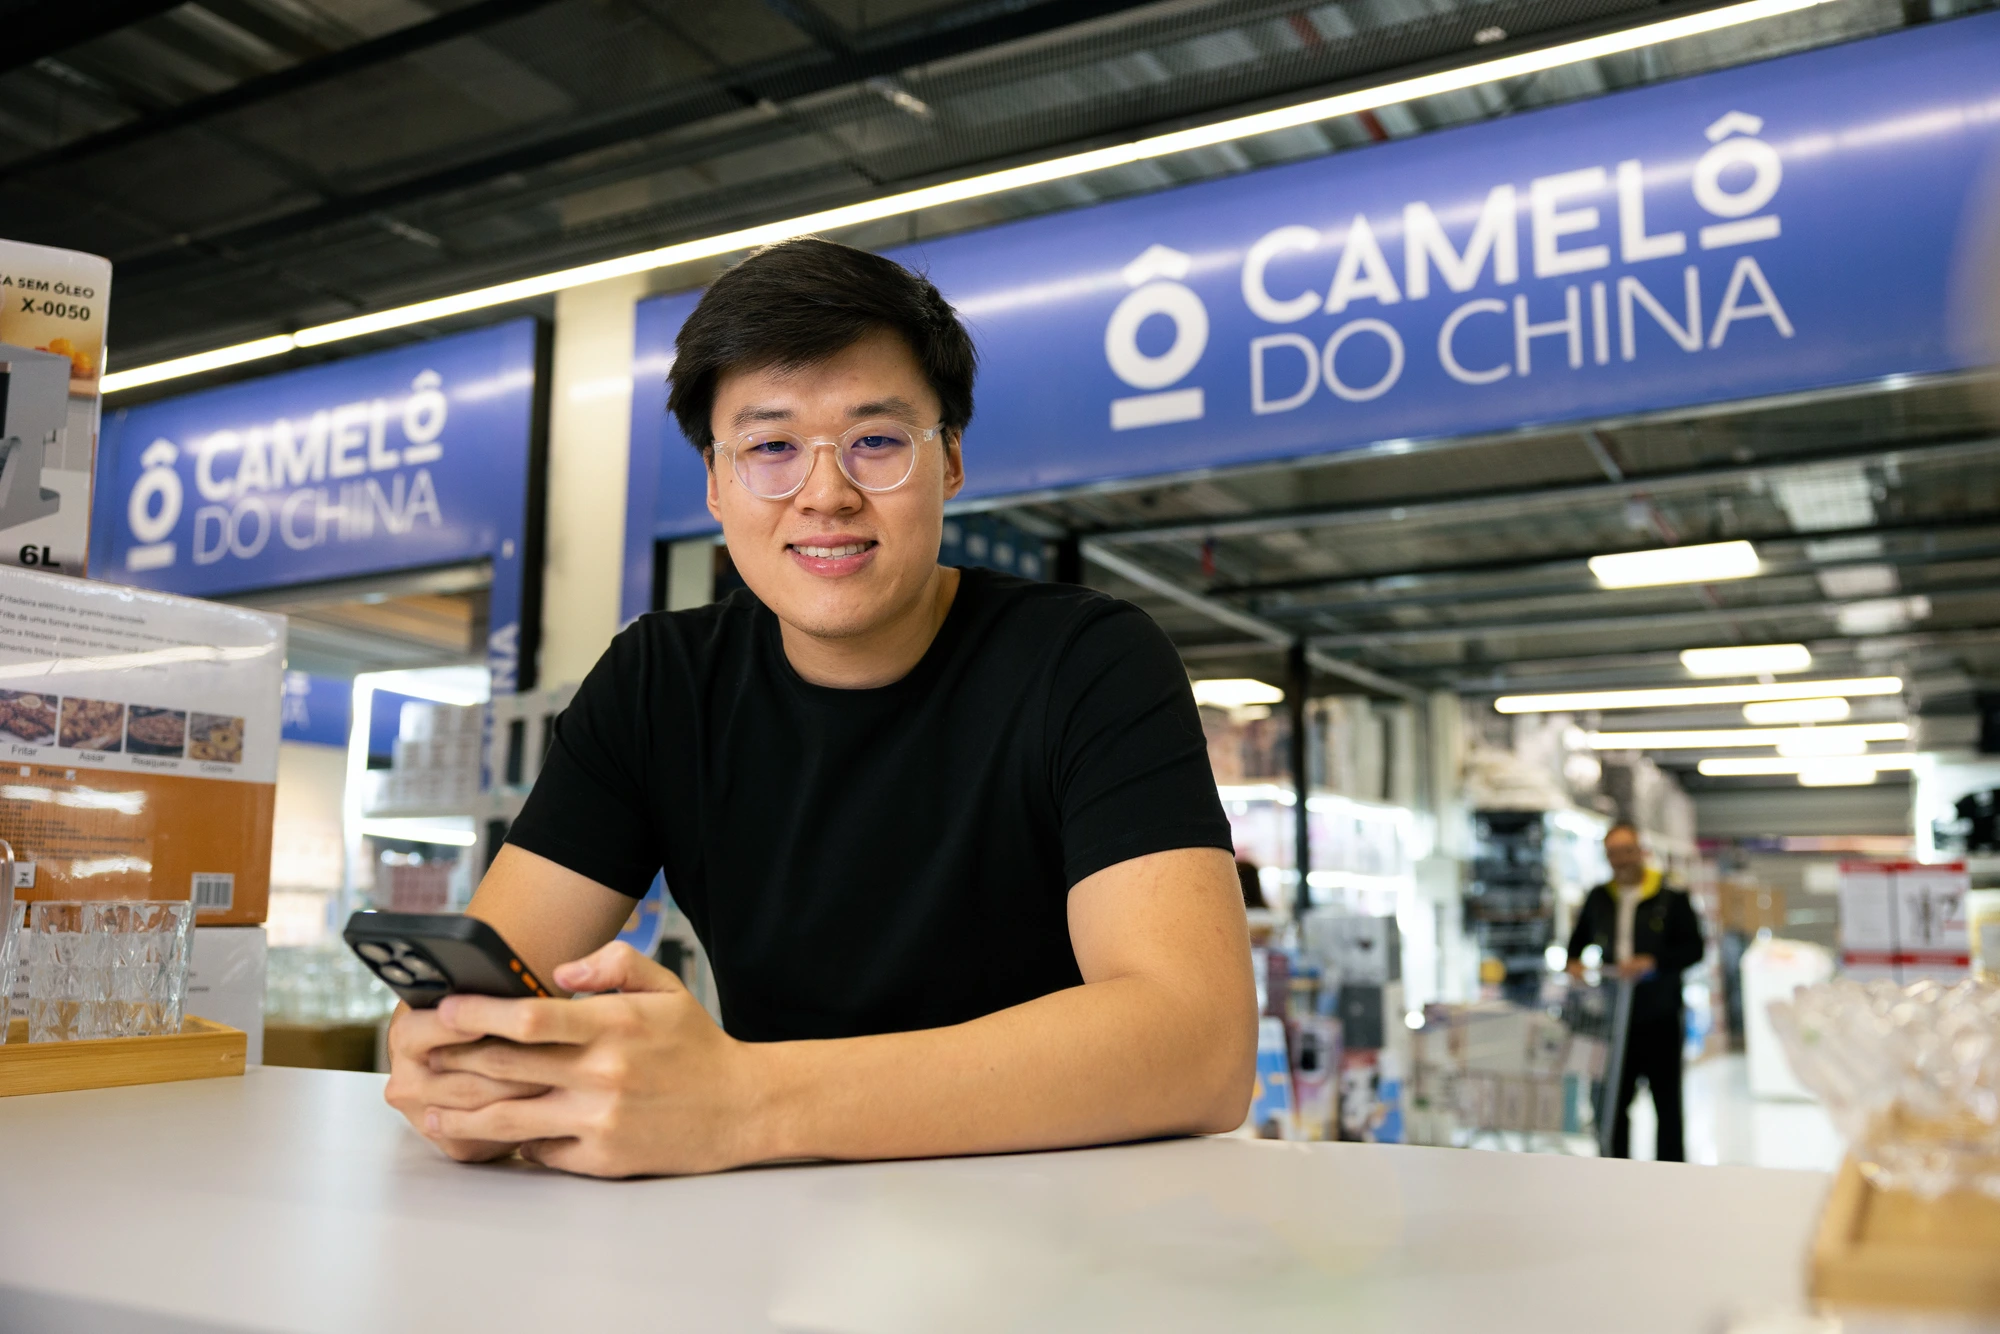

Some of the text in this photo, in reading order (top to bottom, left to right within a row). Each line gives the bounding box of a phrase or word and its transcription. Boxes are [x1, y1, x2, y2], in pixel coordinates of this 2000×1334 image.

[1241, 110, 1783, 324] CAMELÔ
[18, 277, 50, 292] SEM
[53, 281, 95, 299] ÓLEO
[21, 297, 91, 321] X-0050
[1250, 255, 1796, 416] DO CHINA
[195, 368, 448, 501] CAMELÔ
[192, 467, 444, 566] DO CHINA
[19, 545, 61, 568] 6L
[11, 744, 38, 757] Fritar
